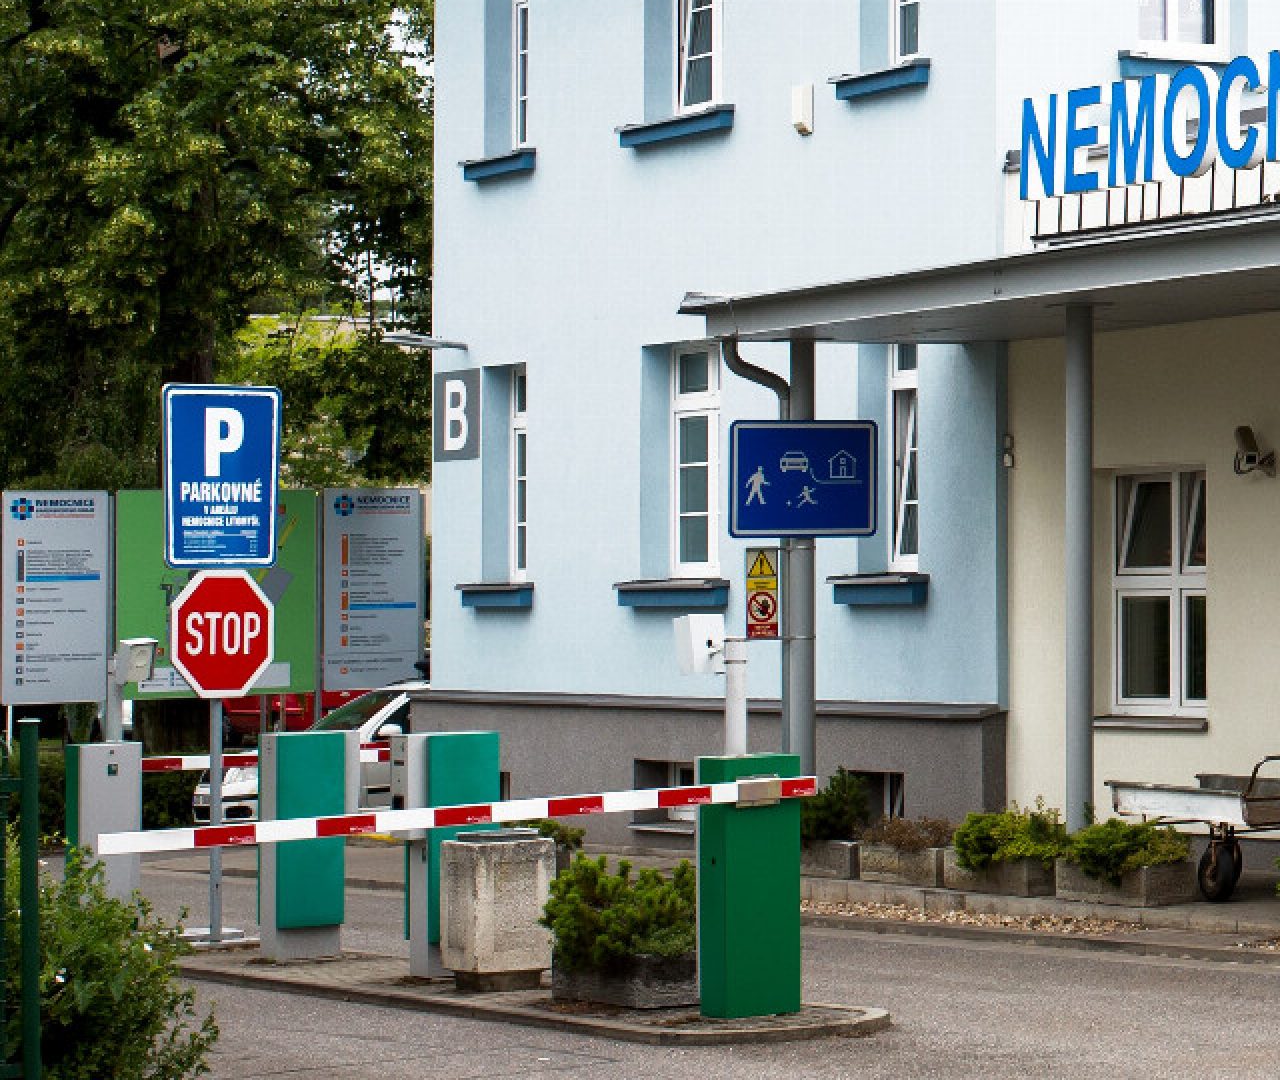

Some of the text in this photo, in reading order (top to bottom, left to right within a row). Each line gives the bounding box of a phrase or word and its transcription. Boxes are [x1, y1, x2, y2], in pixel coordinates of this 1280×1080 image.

[204, 406, 246, 477] P
[444, 379, 468, 452] B
[180, 478, 263, 503] PARKOVNÉ
[185, 611, 261, 656] STOP
